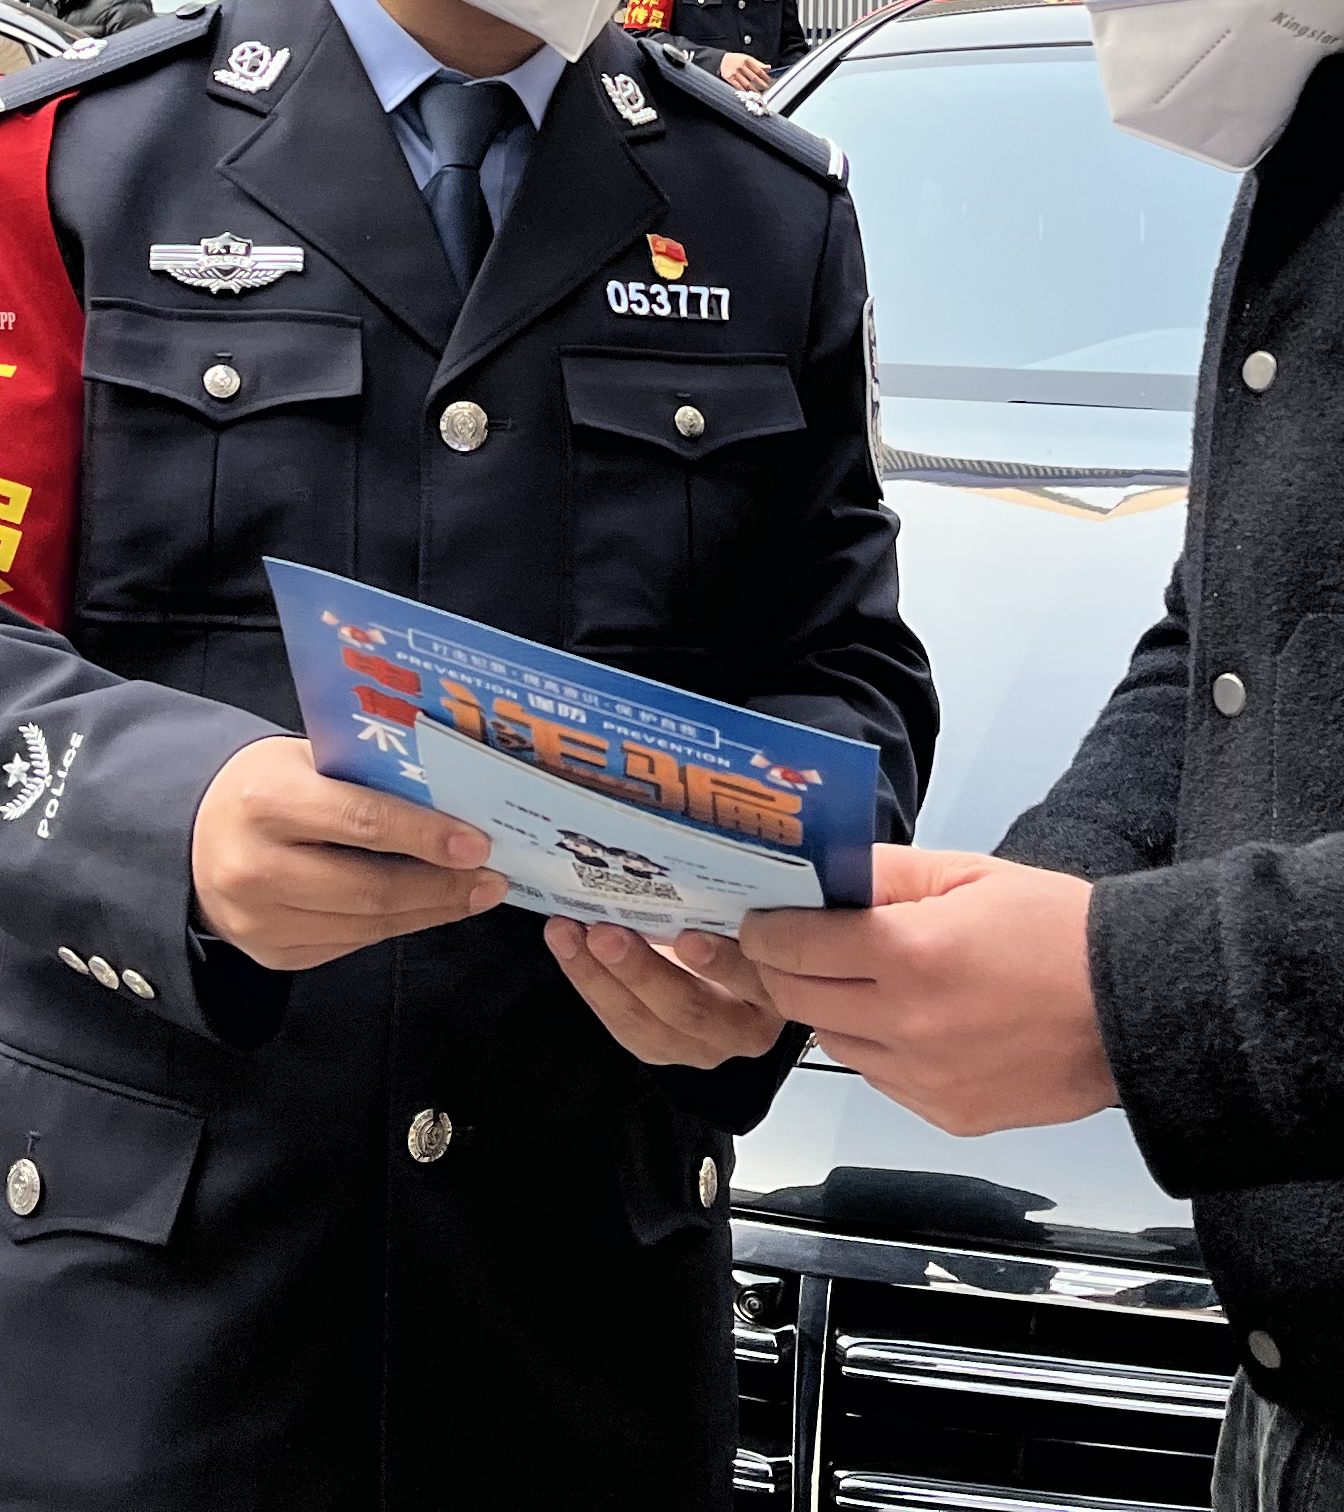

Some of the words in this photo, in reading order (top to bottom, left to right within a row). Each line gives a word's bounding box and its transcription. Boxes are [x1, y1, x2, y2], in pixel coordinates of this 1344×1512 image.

[207, 255, 247, 266] POLICE
[606, 280, 730, 321] 053777
[396, 651, 518, 700] PREVENTION
[603, 720, 731, 769] PREVENTION
[37, 732, 84, 838] POLICE
